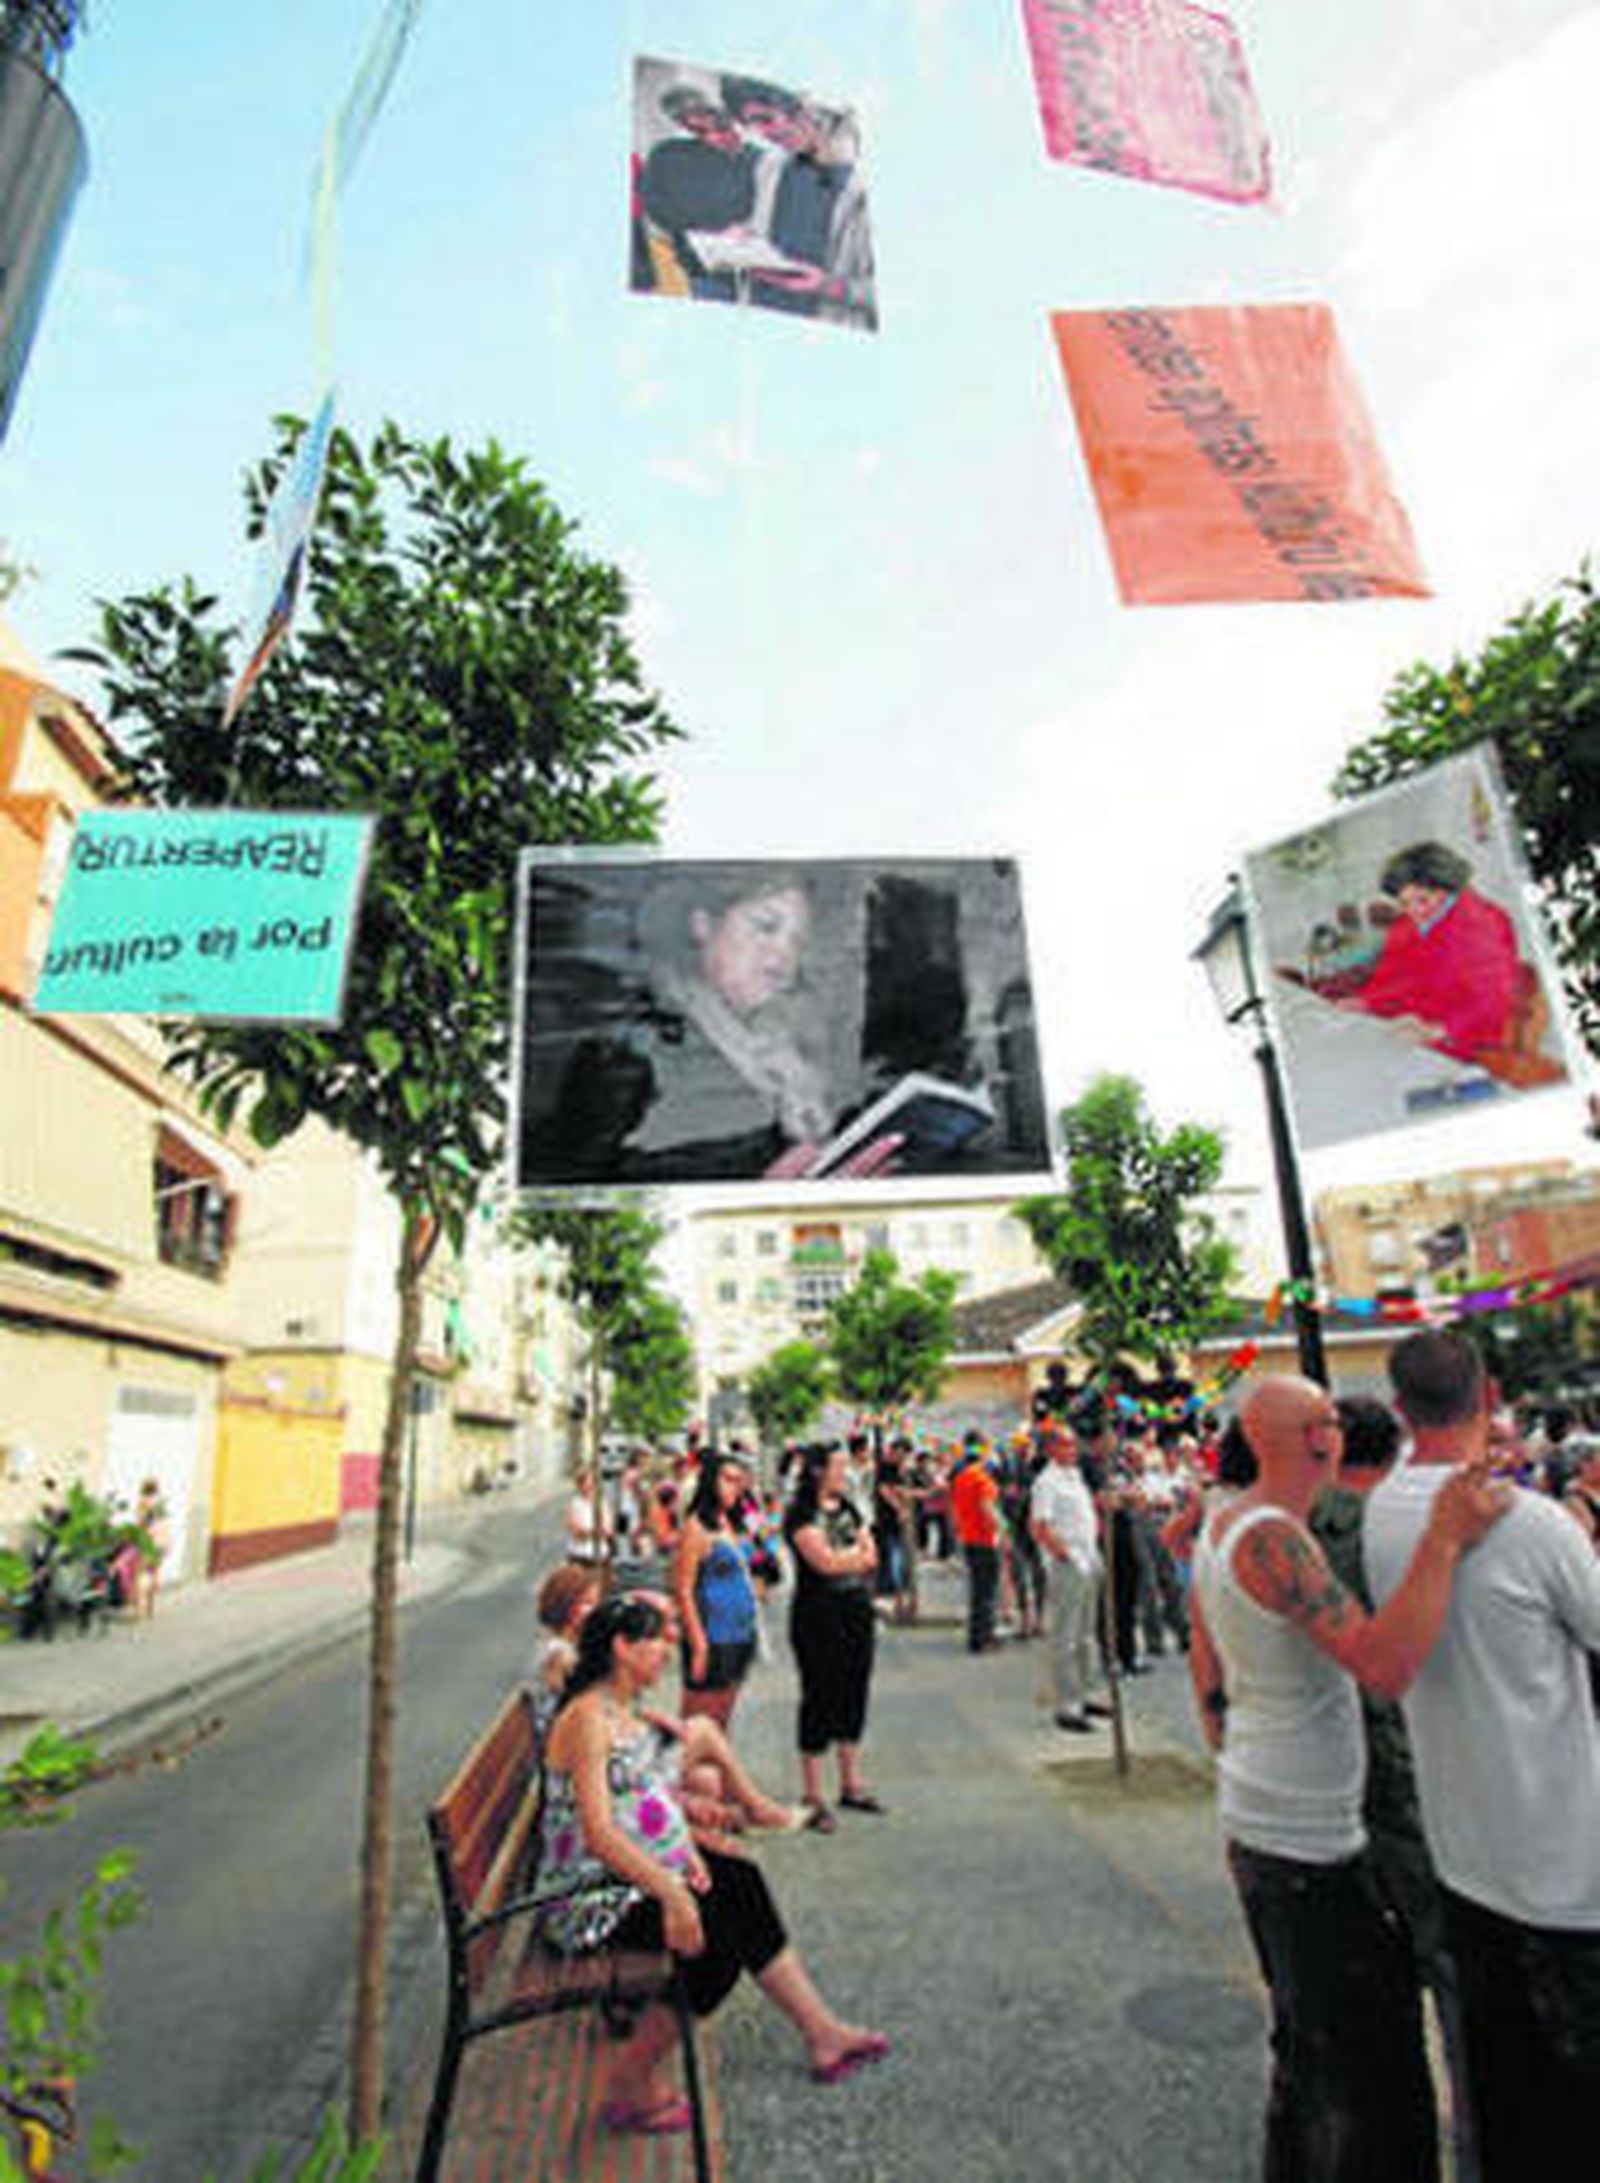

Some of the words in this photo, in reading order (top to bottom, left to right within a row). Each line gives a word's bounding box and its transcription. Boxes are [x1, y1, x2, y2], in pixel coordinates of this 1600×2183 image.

[72, 831, 327, 876] REAPERTUR
[198, 929, 237, 962] la
[249, 917, 332, 952] Por
